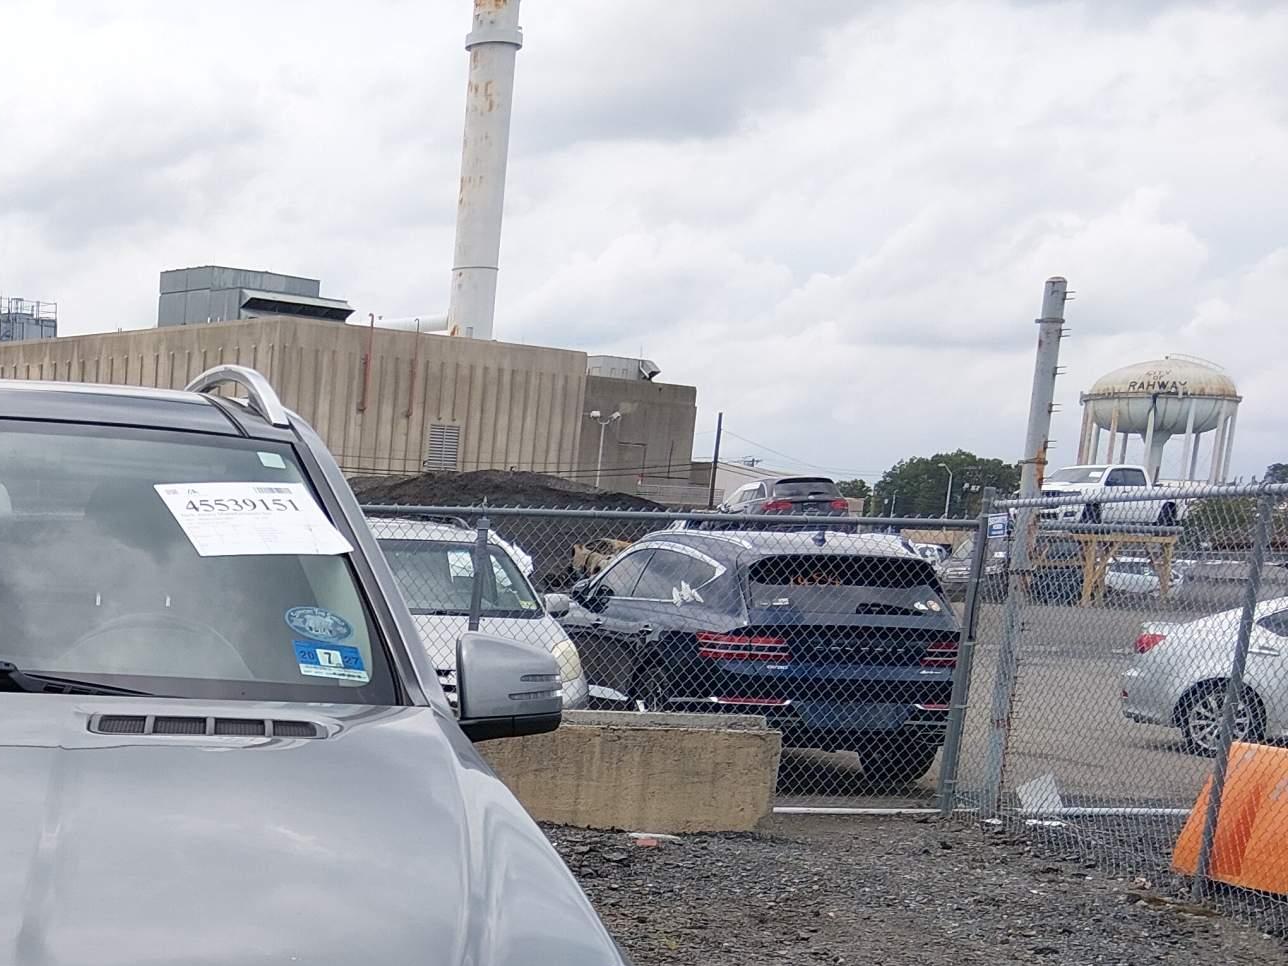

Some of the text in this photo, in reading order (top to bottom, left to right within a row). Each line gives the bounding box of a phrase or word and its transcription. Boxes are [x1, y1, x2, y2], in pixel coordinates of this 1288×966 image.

[1128, 380, 1188, 391] RAHWAY
[185, 498, 300, 512] 45539151
[299, 650, 359, 665] 20 7 27
